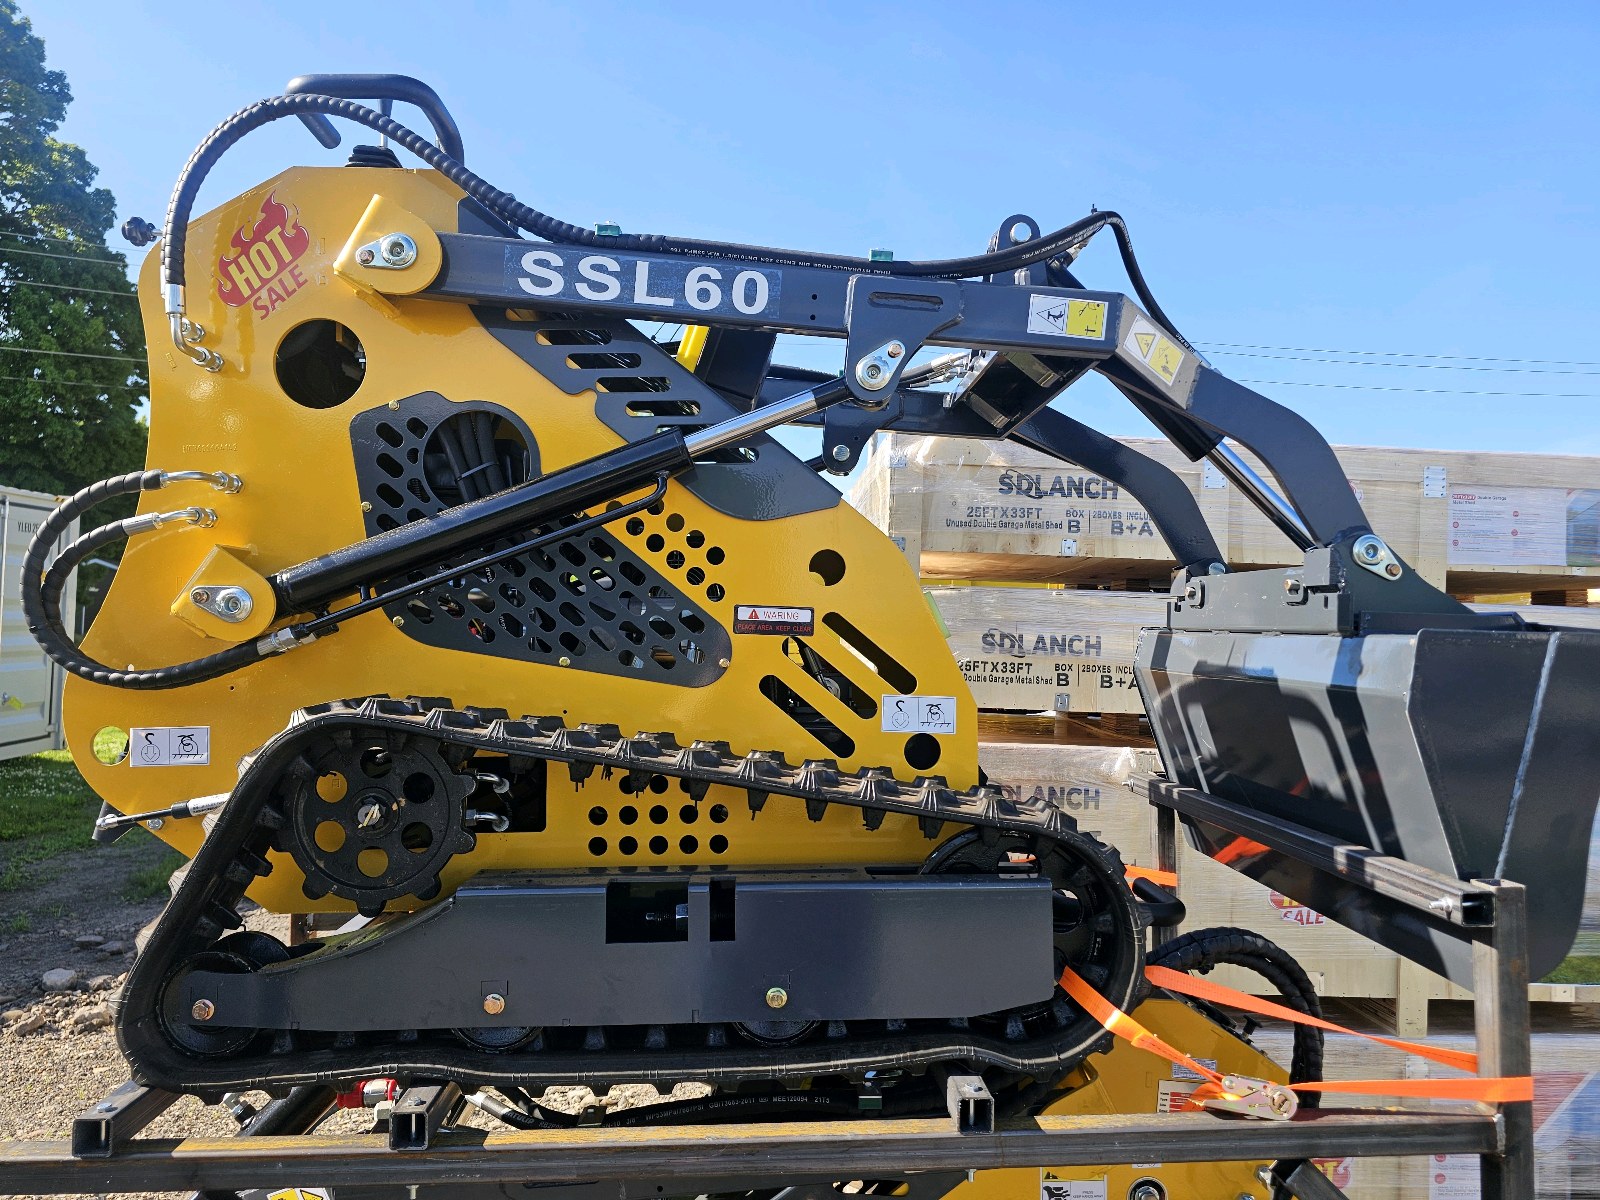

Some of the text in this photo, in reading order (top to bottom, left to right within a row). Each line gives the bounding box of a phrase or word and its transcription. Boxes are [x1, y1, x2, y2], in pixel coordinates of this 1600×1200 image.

[227, 224, 293, 298] HOT
[517, 250, 769, 315] SSL60
[252, 264, 308, 320] SALE
[998, 469, 1118, 500] SDLANCH
[1066, 509, 1084, 518] BOX
[1092, 511, 1151, 521] 2BOXES INCLU
[946, 518, 1063, 530] Unused Double Garage Metal Shed
[1068, 520, 1080, 534] B
[1110, 520, 1154, 536] B+A
[764, 612, 799, 620] WARING
[982, 628, 1101, 658] SDLANCH
[1055, 664, 1073, 672] BOX
[1082, 664, 1134, 674] 2BOXES INCL
[964, 673, 1052, 685] Double Garage Metal Shed
[1056, 673, 1070, 686] B
